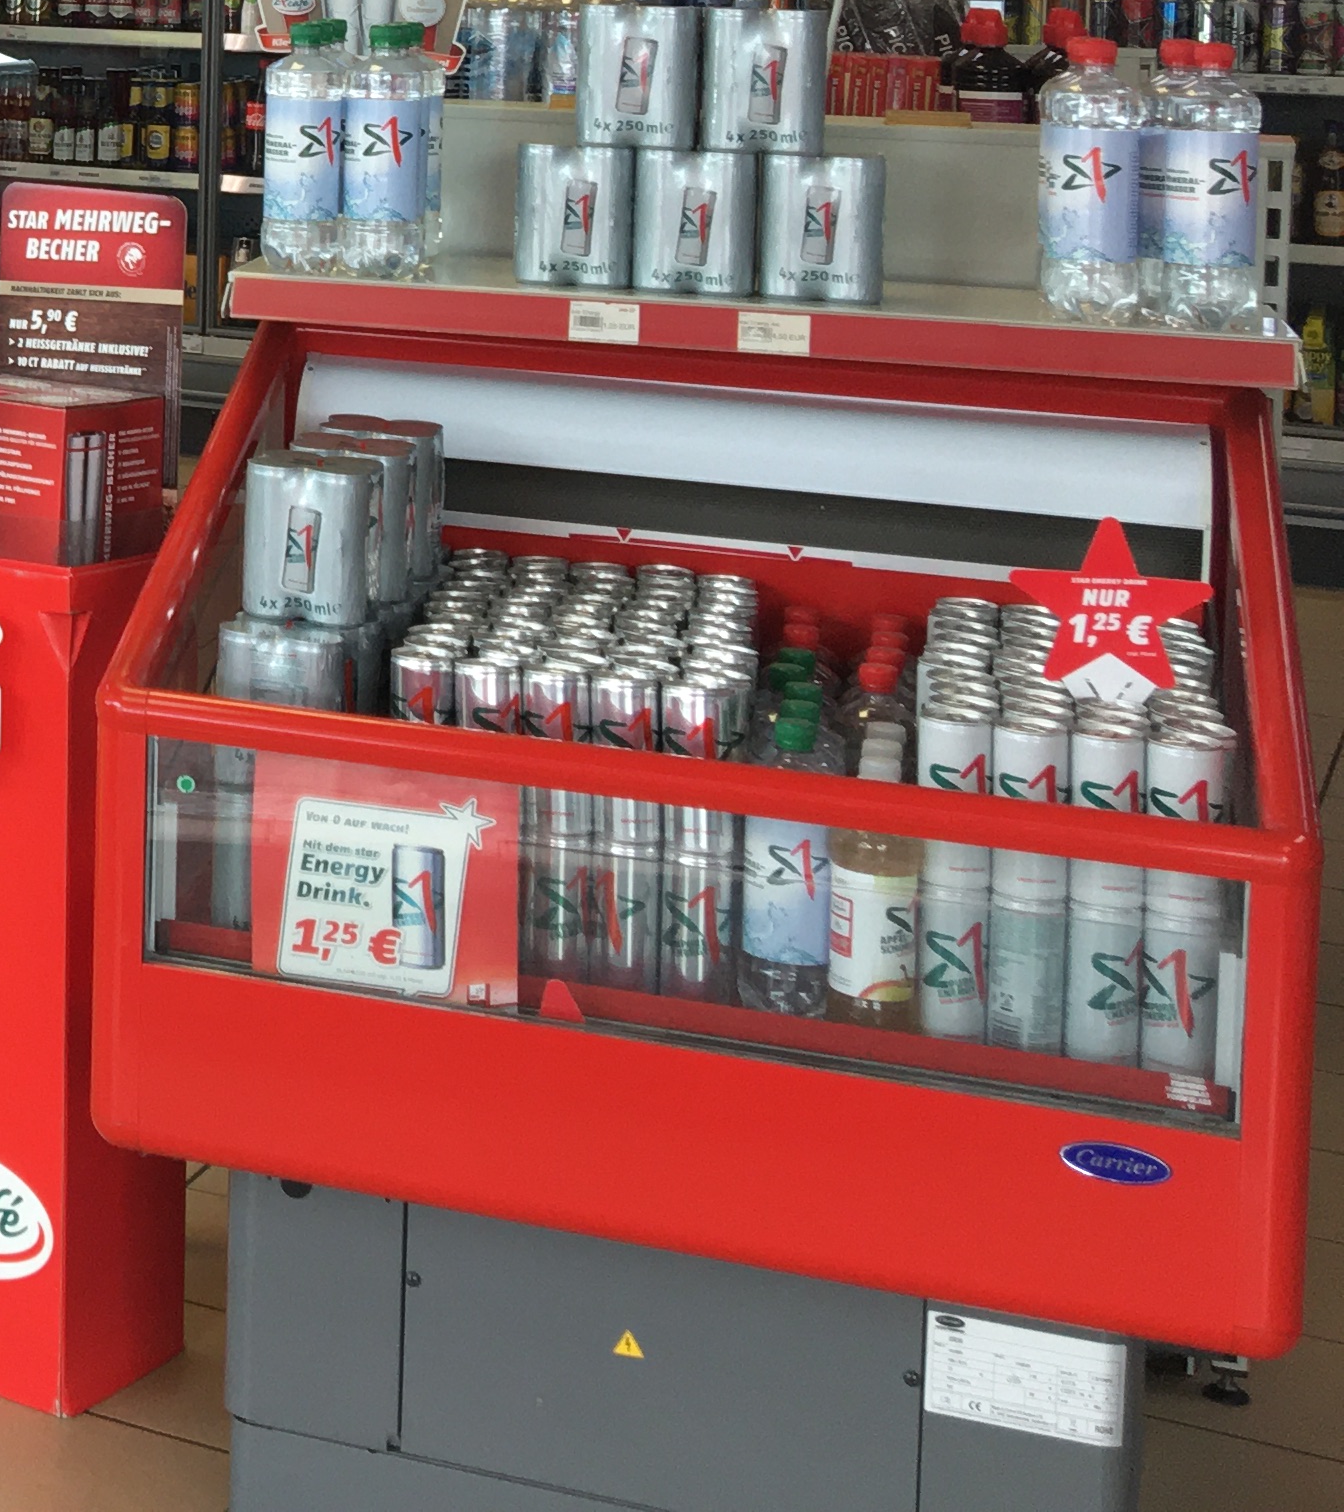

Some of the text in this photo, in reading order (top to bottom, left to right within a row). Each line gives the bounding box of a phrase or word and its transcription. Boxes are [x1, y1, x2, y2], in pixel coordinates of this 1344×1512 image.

[7, 209, 171, 234] STAR MEHRWEG-
[26, 238, 100, 262] BECHER
[9, 309, 78, 335] NUR 5,90 €
[17, 338, 24, 348] 2
[25, 337, 96, 353] HEISSGETRÄNKE
[17, 357, 27, 367] 10
[41, 358, 75, 371] RABATT
[1082, 589, 1130, 607] NUR
[1069, 613, 1154, 648] 1,25 €
[303, 839, 380, 858] Mit dem star
[300, 853, 385, 884] Energy
[297, 880, 371, 908] Drink.
[292, 918, 402, 965] 1,25 €
[1075, 1148, 1158, 1179] Carrier
